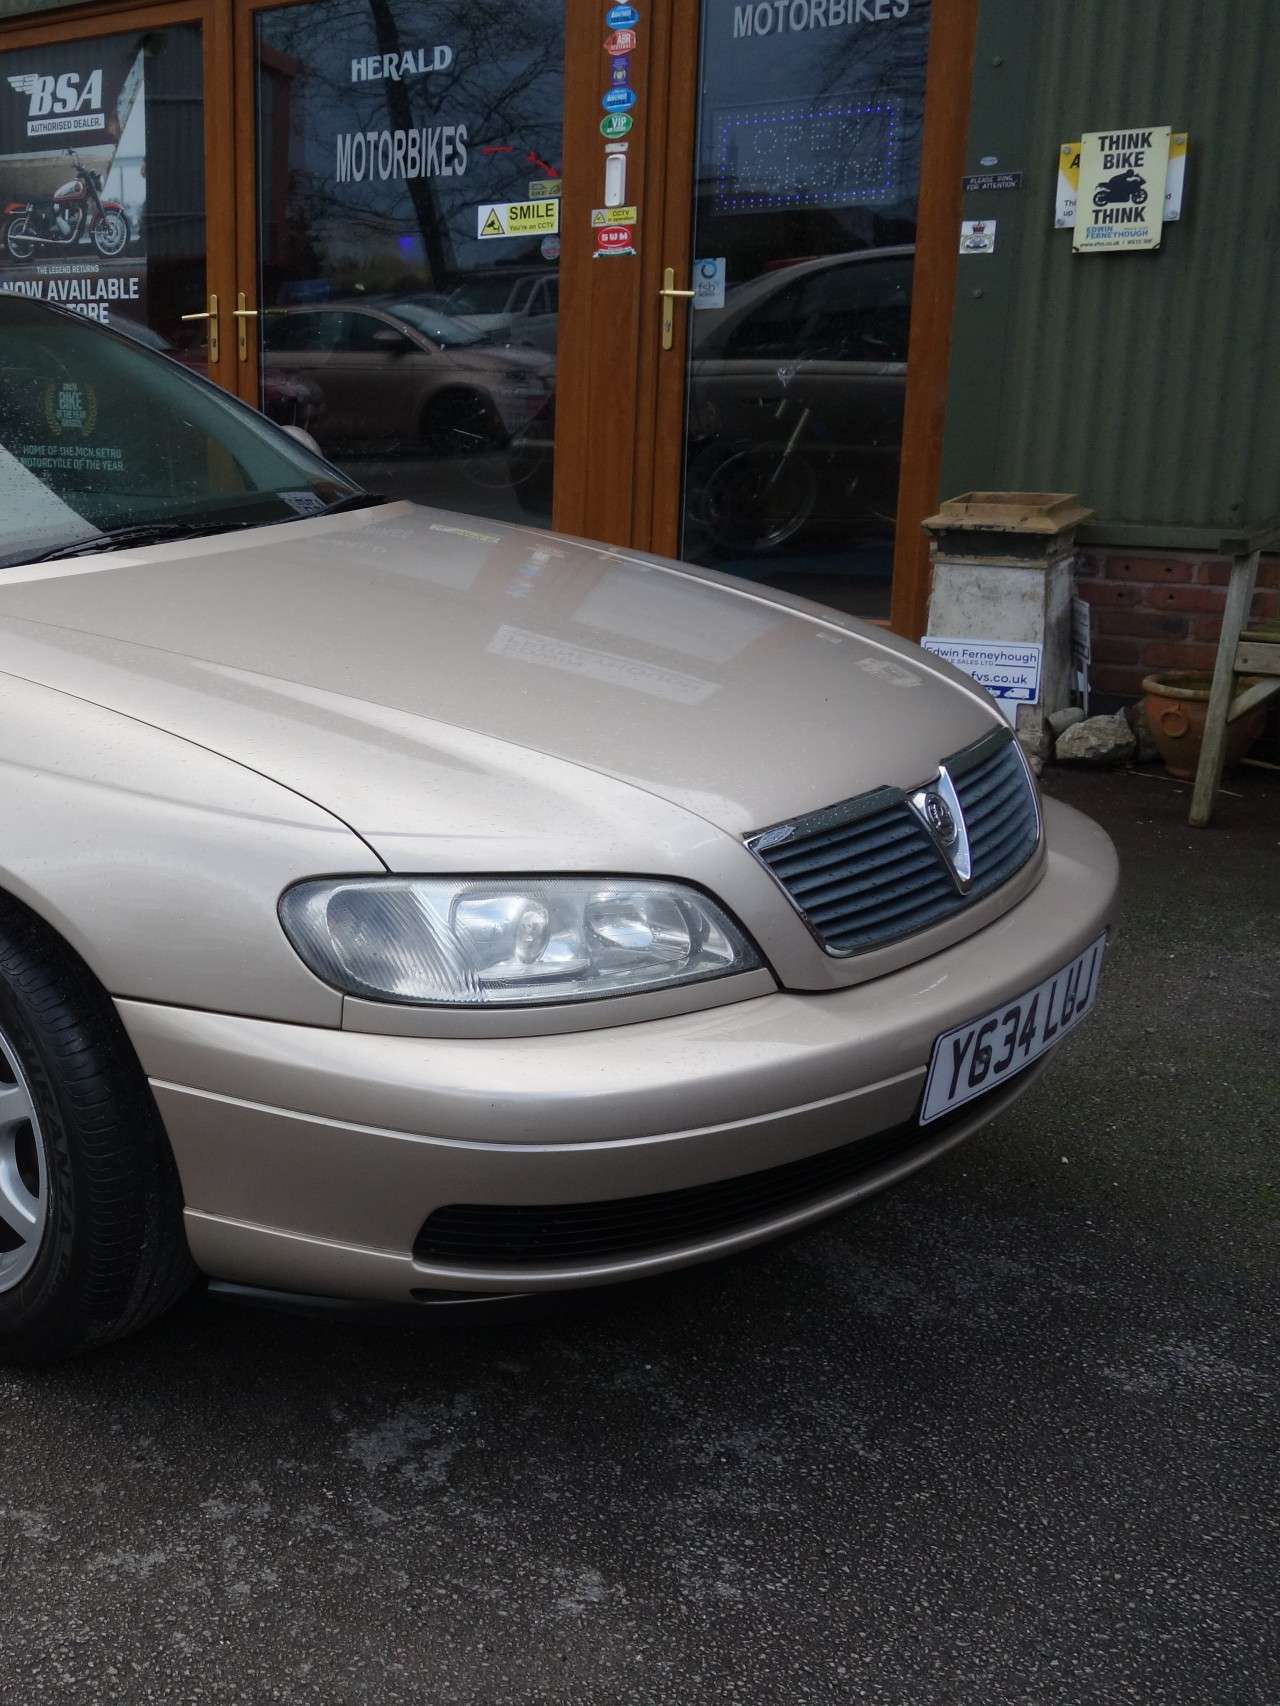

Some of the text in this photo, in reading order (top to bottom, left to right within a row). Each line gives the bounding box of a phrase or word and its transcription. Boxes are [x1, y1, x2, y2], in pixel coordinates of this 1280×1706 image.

[733, 0, 910, 38] MOTORBIKES
[351, 45, 453, 82] HERALD
[28, 69, 103, 116] BSA
[30, 120, 72, 134] AUTHORISED
[1098, 132, 1153, 152] THINK
[336, 124, 468, 183] MOTORBIKES
[1103, 151, 1145, 170] BIKE
[982, 182, 1016, 190] ATTENTION
[509, 203, 555, 221] SMILE
[1092, 206, 1146, 224] THINK
[537, 221, 554, 229] CCTV
[1086, 225, 1114, 233] EDWIN
[1086, 230, 1149, 239] FERNEYHOUGH
[36, 264, 100, 274] THE LEGEND RETURNS
[47, 277, 140, 300] AVAILABLE
[962, 649, 1037, 665] Ferneyhough
[948, 992, 1040, 1100] Y634
